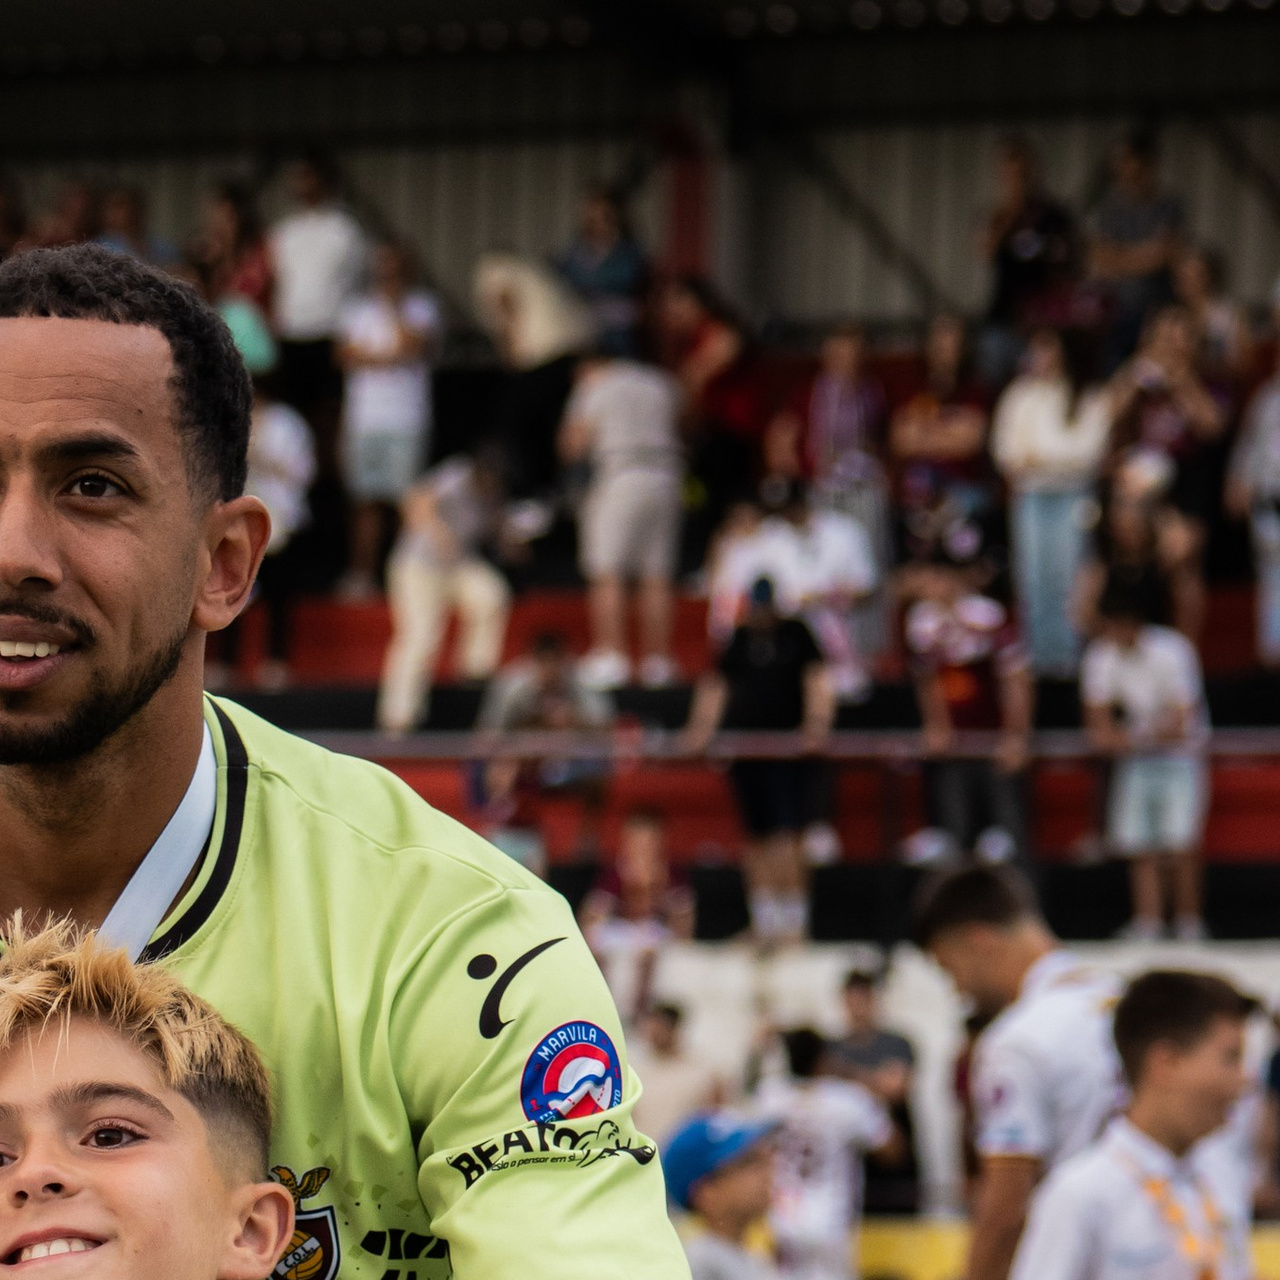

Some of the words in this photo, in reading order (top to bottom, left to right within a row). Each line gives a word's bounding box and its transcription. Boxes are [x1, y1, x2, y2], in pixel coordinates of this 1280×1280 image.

[537, 1025, 597, 1062] MARVILA
[517, 1156, 549, 1168] pensar
[284, 1246, 315, 1269] C.O.L.
